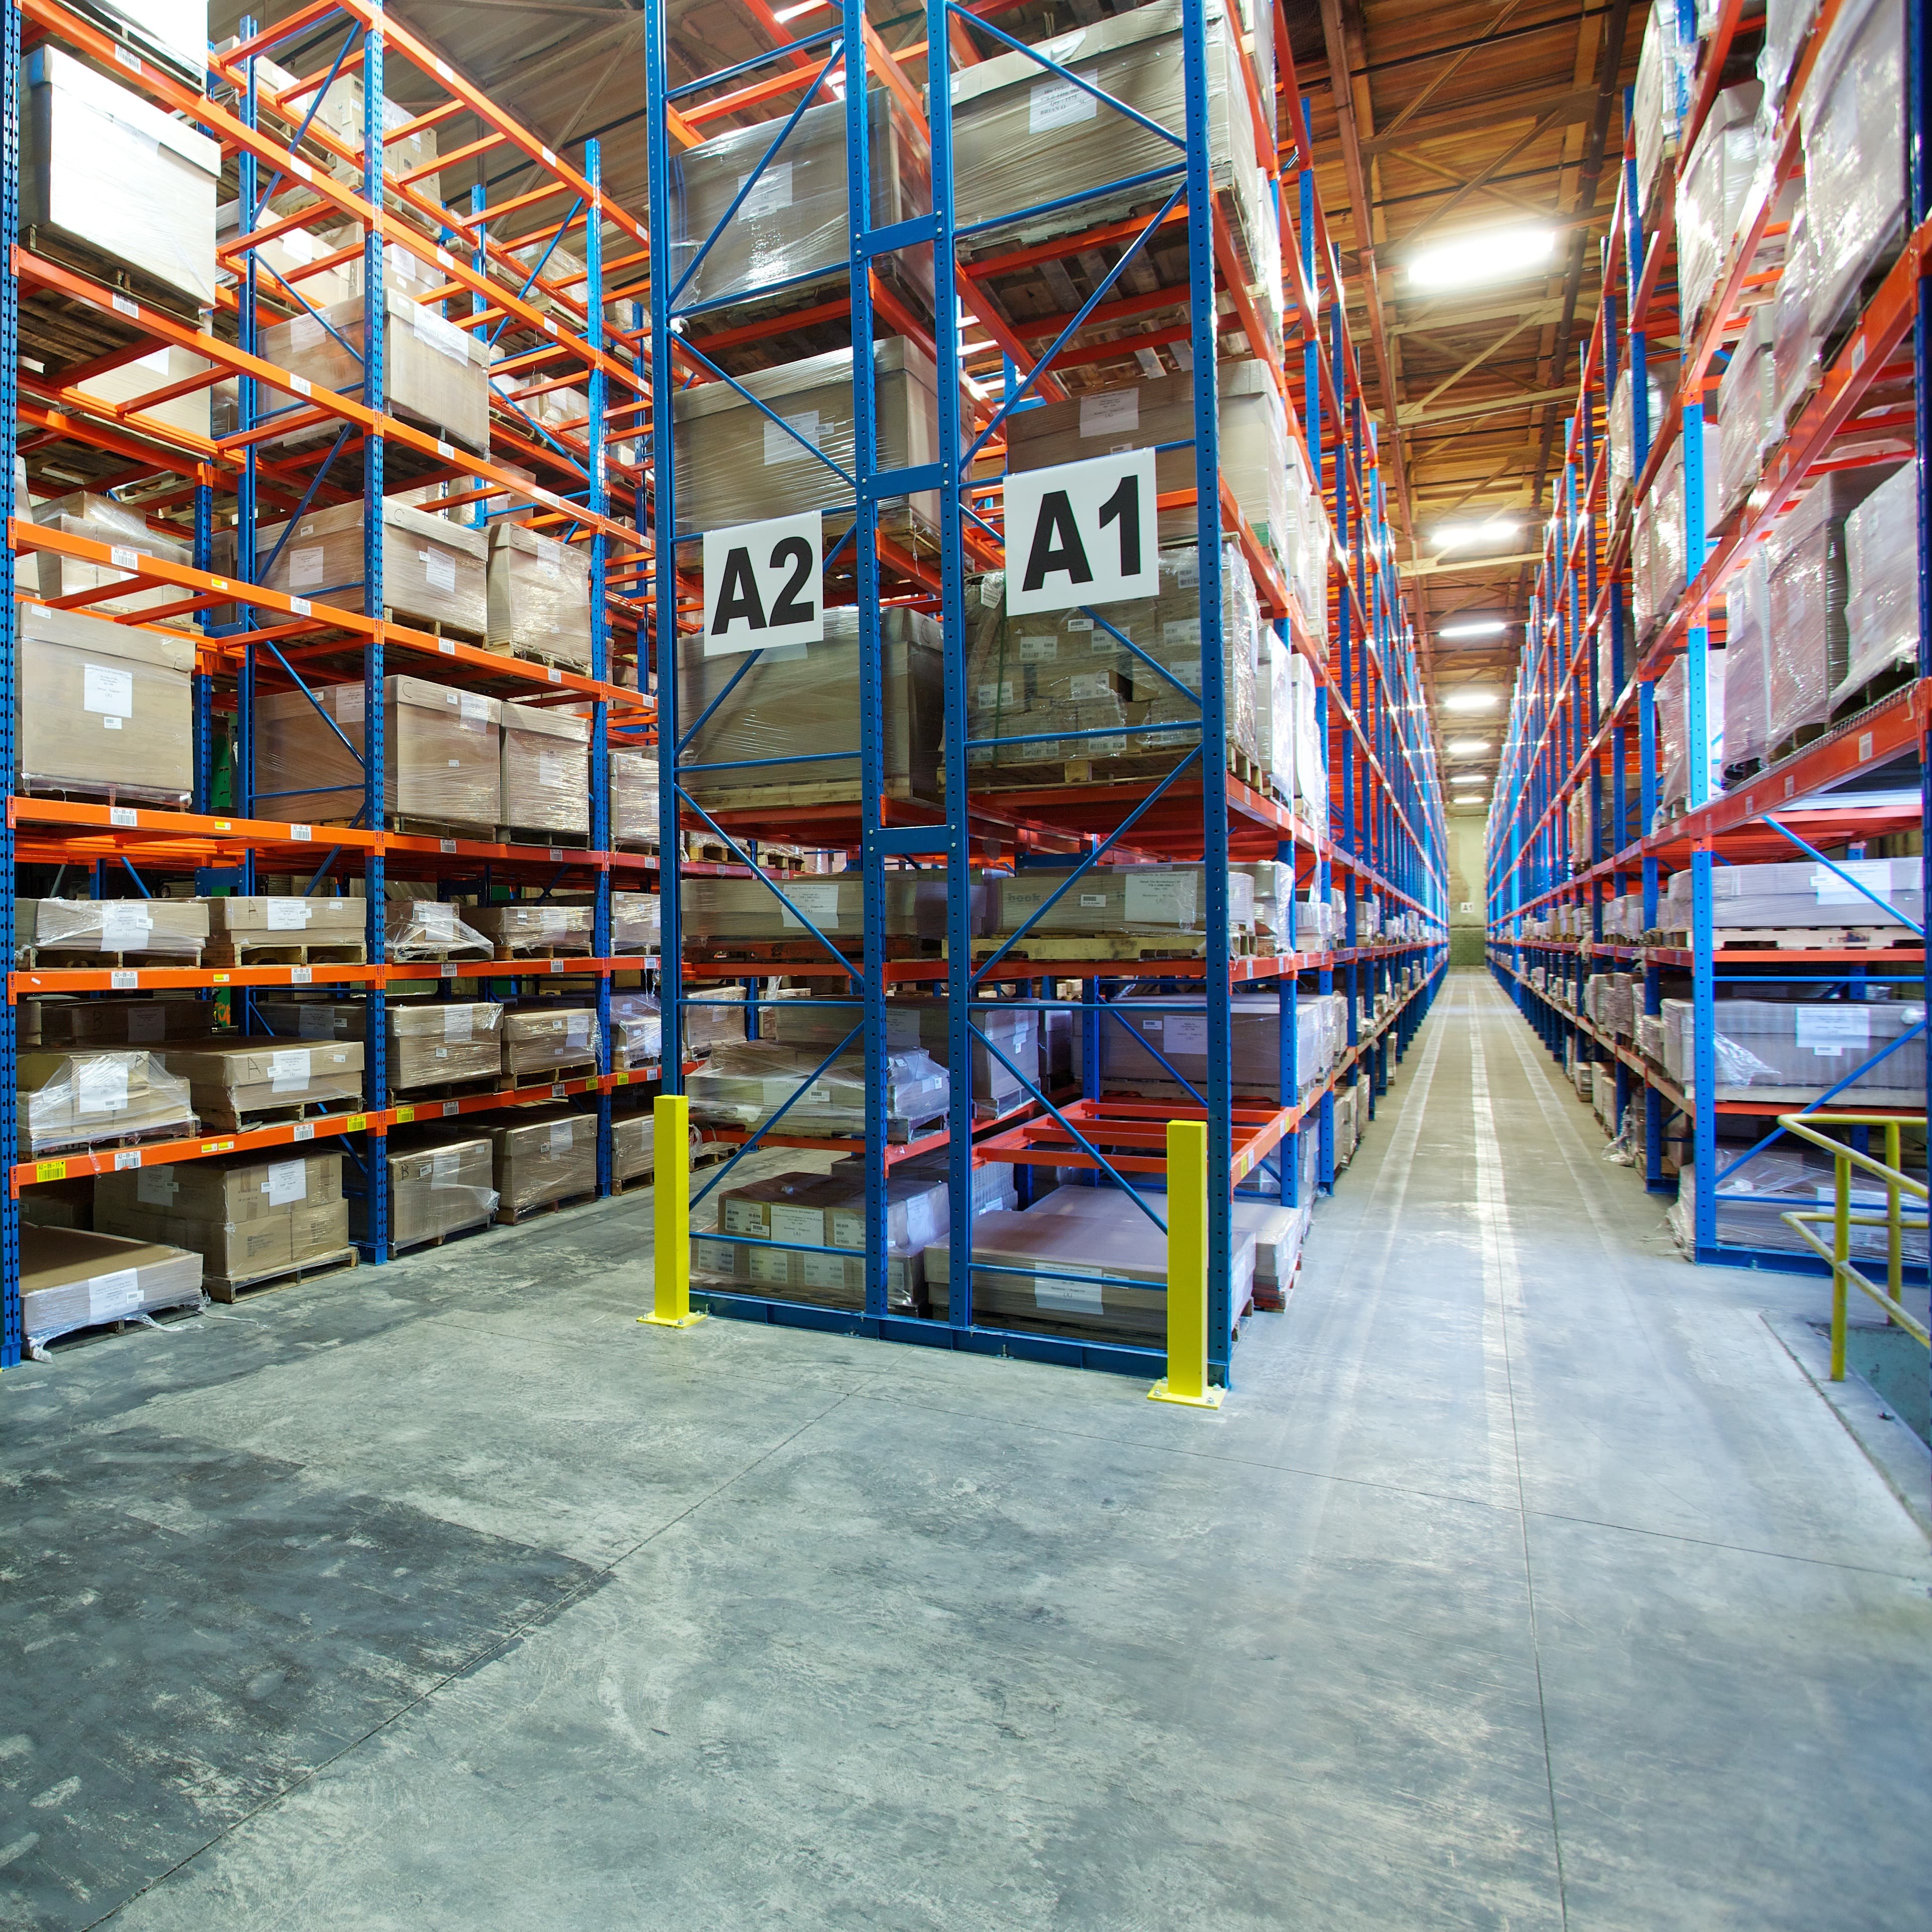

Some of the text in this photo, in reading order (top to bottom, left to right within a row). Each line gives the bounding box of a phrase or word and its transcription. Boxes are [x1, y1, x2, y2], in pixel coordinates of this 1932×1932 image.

[1022, 474, 1141, 592] A1
[711, 536, 814, 635] A2
[249, 899, 259, 922] A
[248, 1056, 262, 1080] A
[400, 1164, 410, 1180] B
